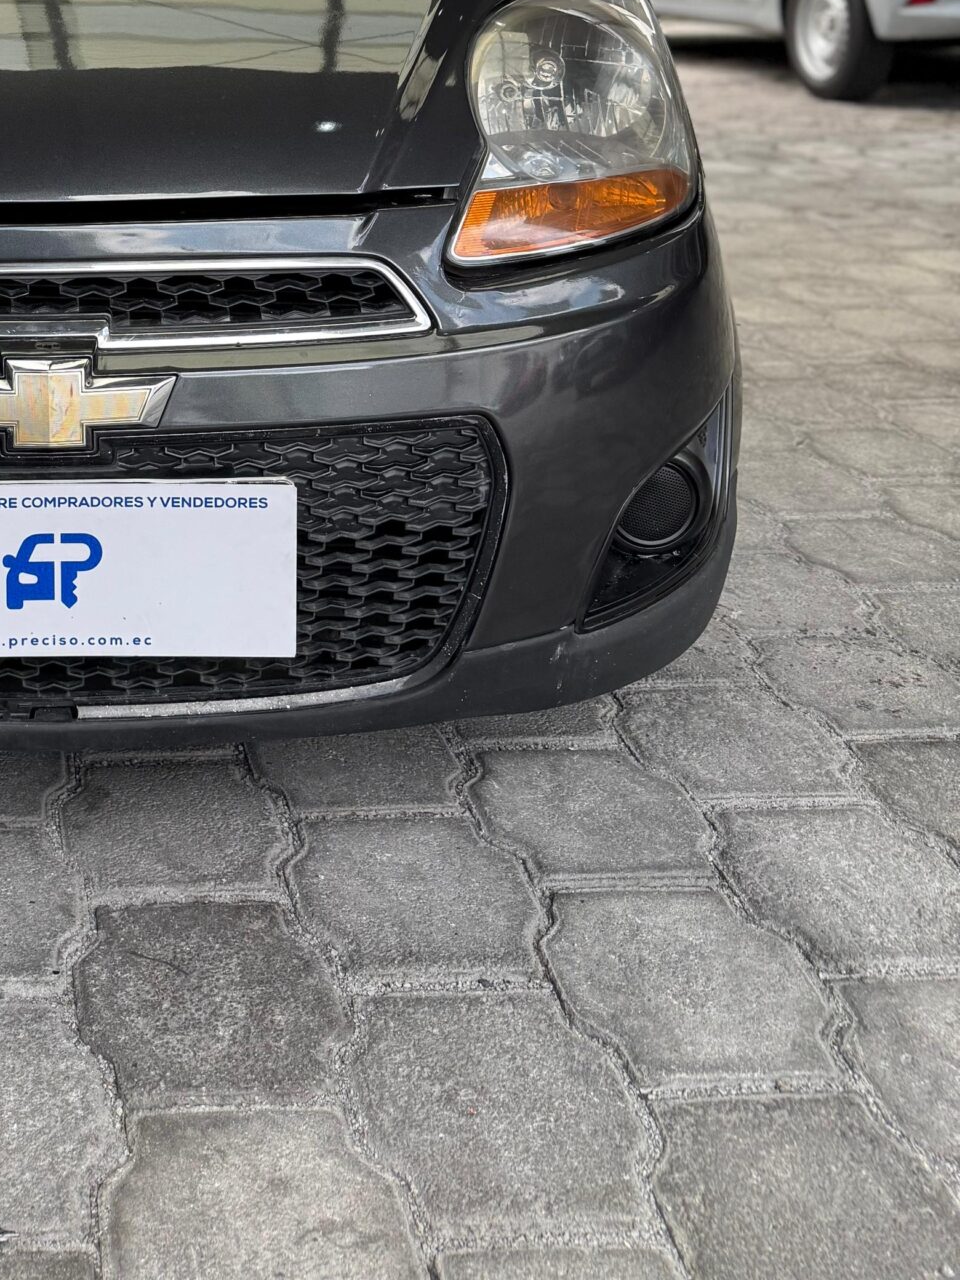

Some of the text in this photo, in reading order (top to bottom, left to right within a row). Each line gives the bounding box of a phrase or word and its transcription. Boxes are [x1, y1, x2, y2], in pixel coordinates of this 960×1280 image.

[21, 496, 144, 509] COMPRADORES
[146, 496, 158, 508] Y
[159, 496, 269, 509] VENDEDORES
